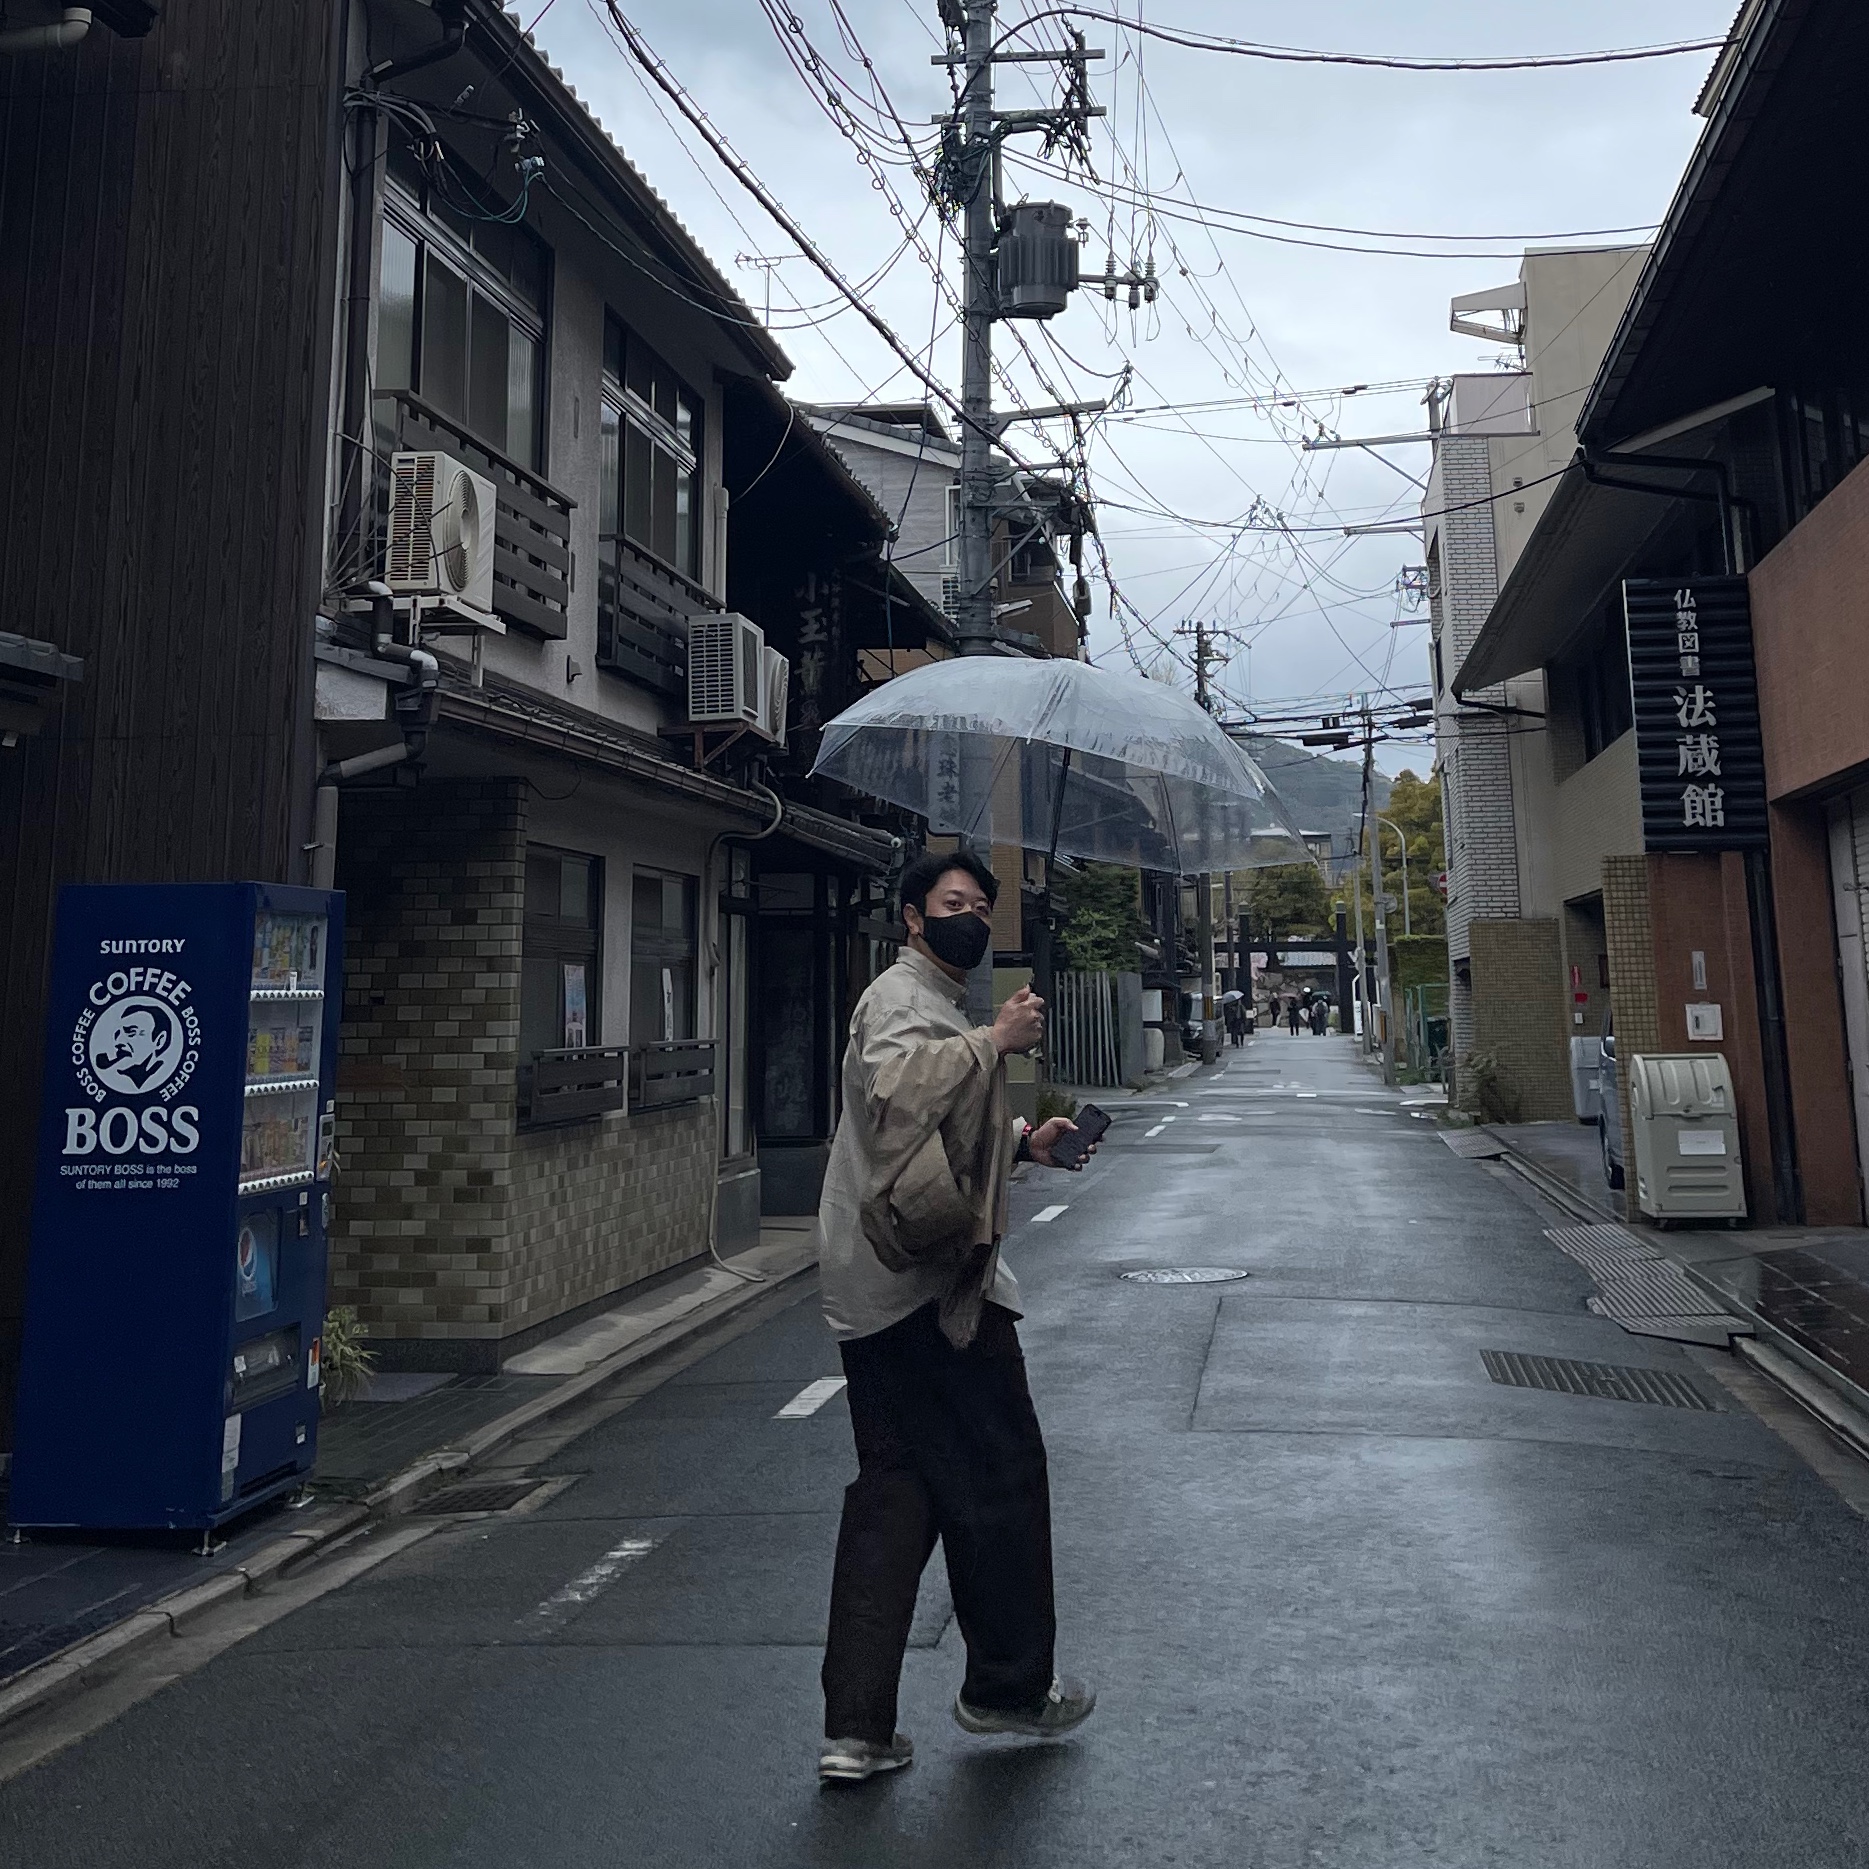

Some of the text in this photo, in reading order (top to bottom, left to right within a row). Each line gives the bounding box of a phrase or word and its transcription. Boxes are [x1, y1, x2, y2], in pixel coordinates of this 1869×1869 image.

[1672, 588, 1725, 828] 仏教図書 法蔵館
[100, 939, 186, 954] SUNTORY
[89, 967, 192, 1006] COFFEE
[71, 1008, 107, 1103] BOSS COFFEE
[159, 1006, 201, 1102] BOSS COFFEE
[61, 1105, 200, 1155] BOSS
[60, 1164, 198, 1176] SUNTORY BOSS is the boss
[75, 1178, 180, 1190] of them all since 1992
